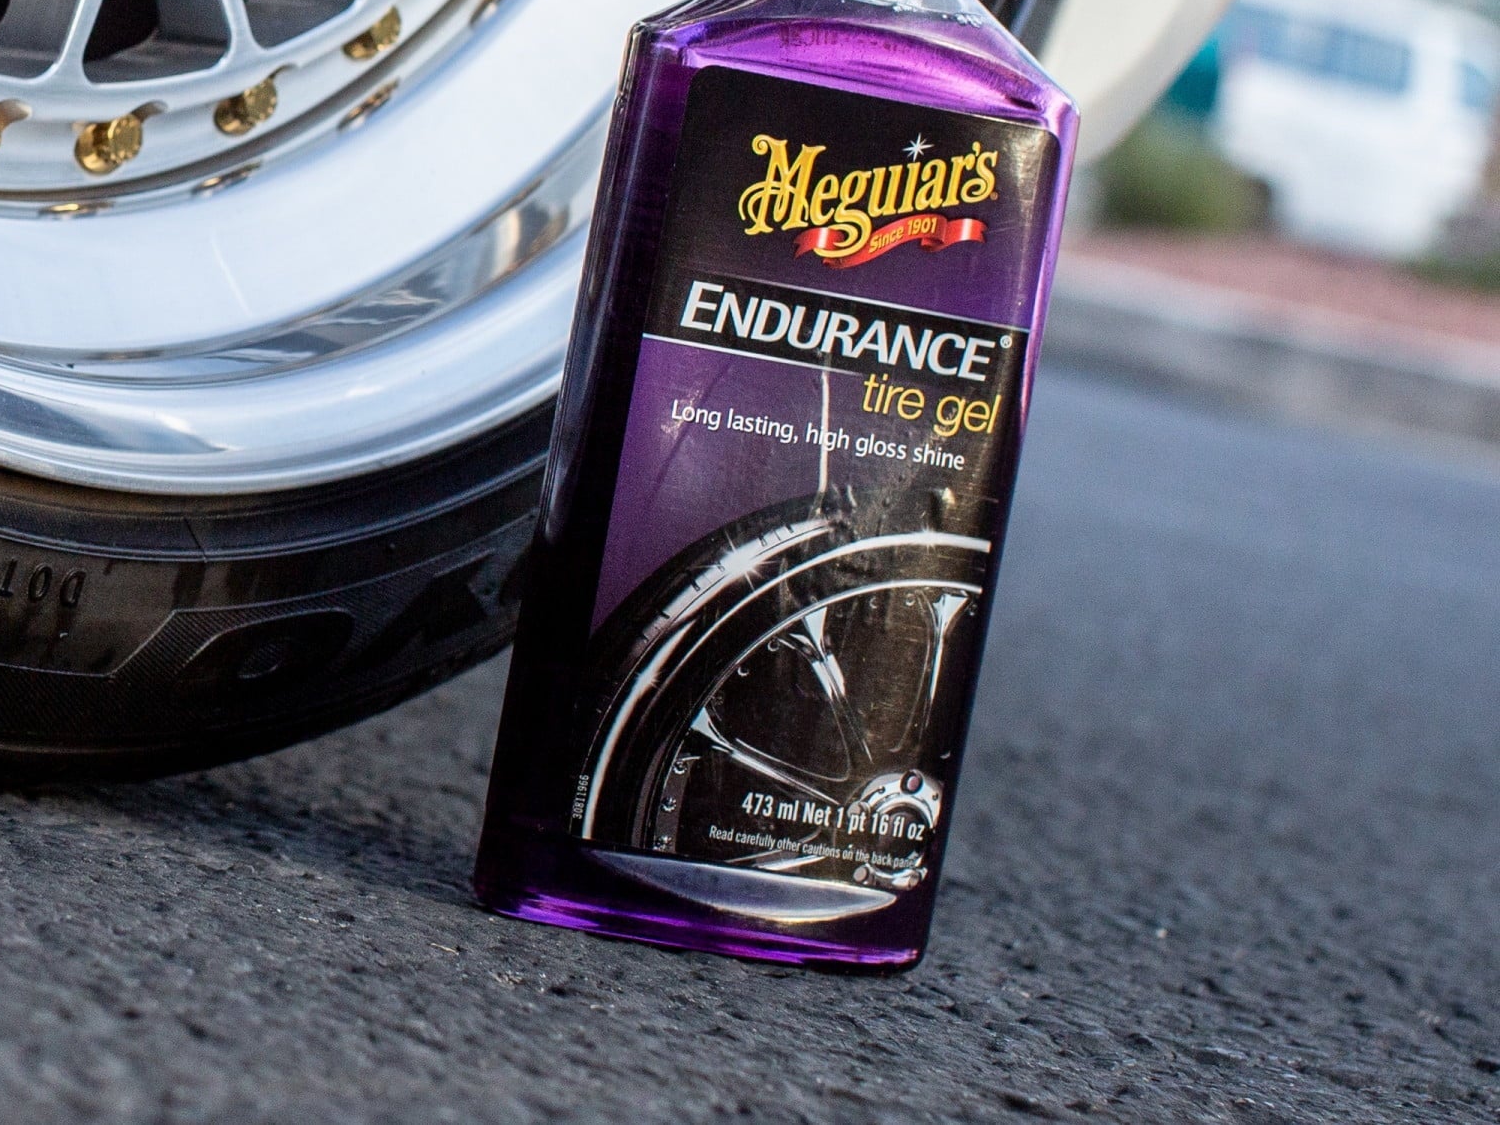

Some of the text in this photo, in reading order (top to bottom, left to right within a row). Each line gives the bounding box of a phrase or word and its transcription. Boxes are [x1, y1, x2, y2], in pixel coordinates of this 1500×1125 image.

[868, 215, 939, 254] Since 1901
[862, 373, 1002, 438] tire gel
[670, 398, 966, 472] Long lasting, high gloss shine
[572, 775, 590, 820] 30811966
[741, 791, 926, 842] 473 ml Net 1 pt 16 fl oz
[708, 825, 734, 842] Read
[735, 831, 776, 850] carefully
[776, 838, 802, 853] other
[801, 841, 841, 860] cautions
[842, 849, 854, 861] on
[855, 847, 871, 863] the
[871, 851, 893, 866] back
